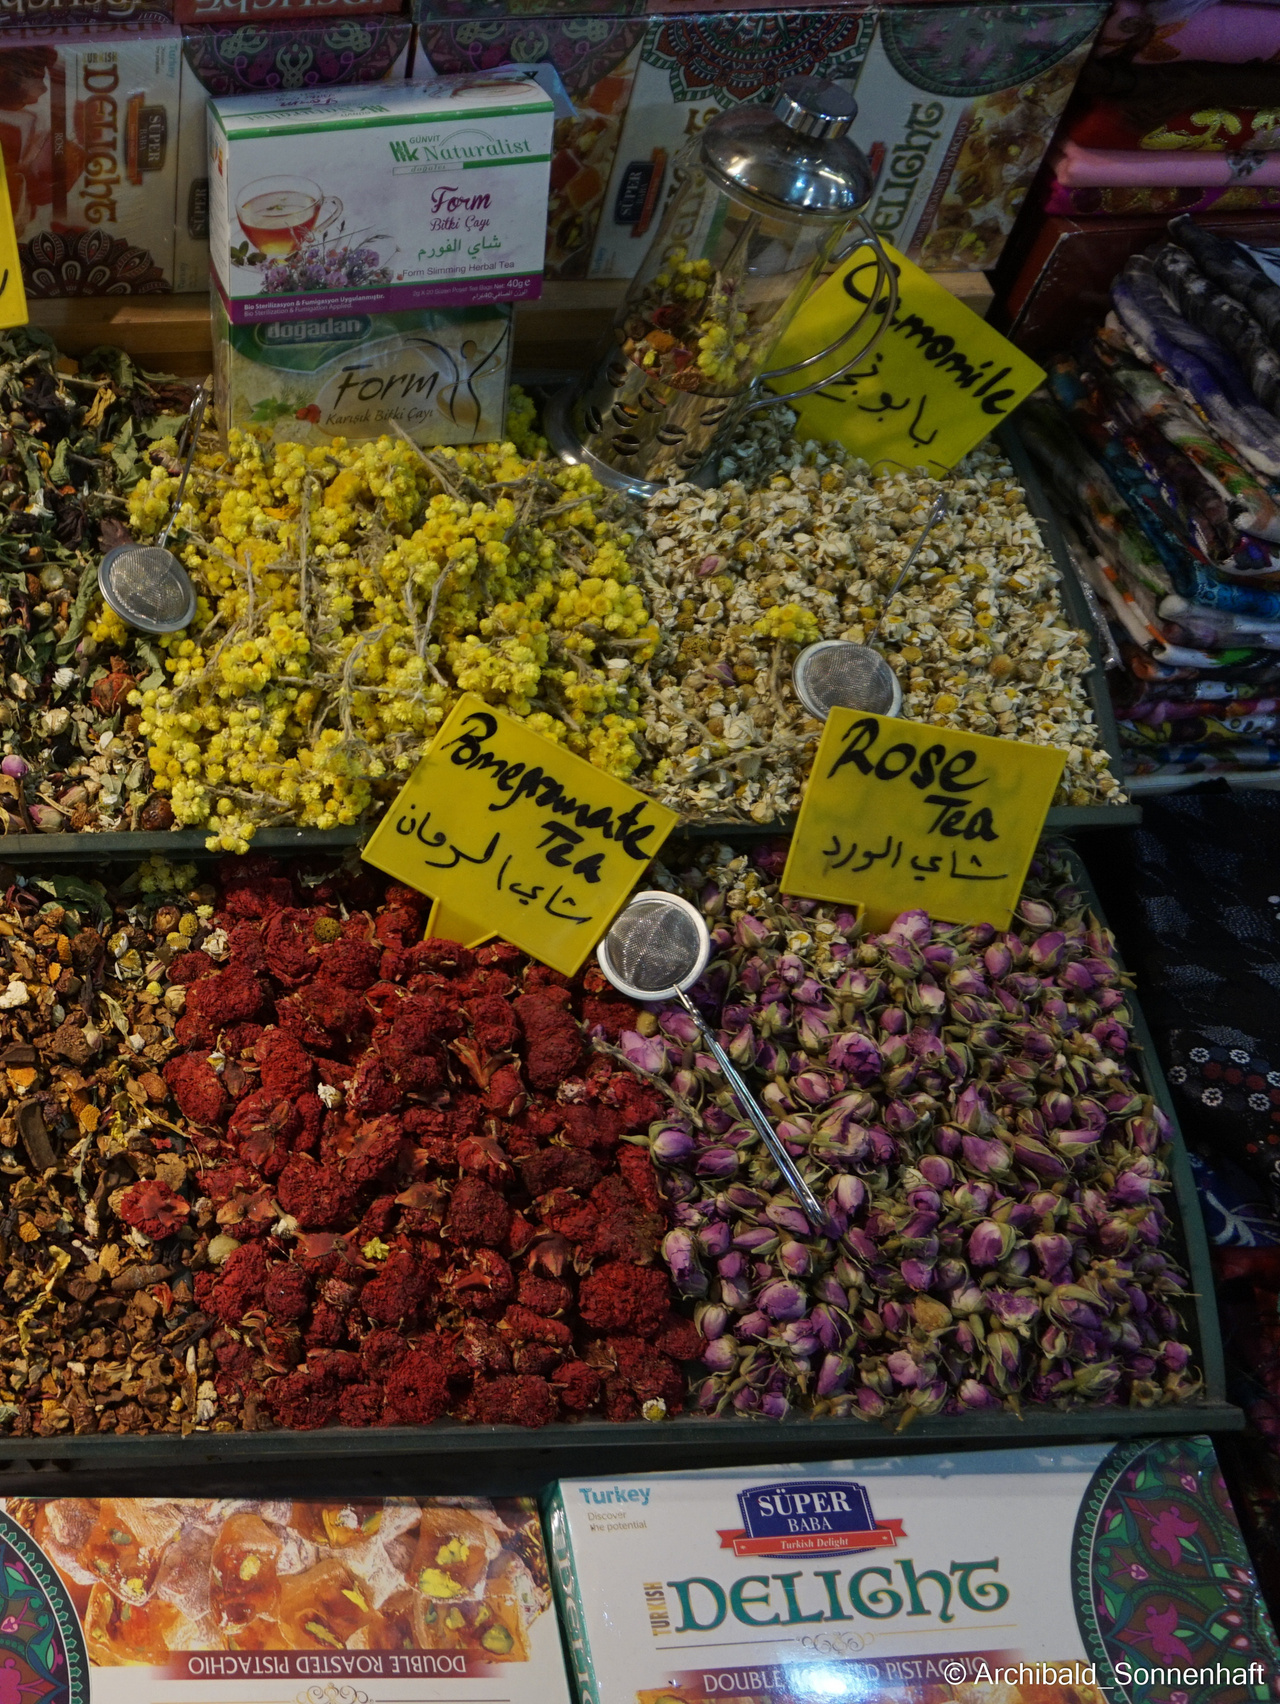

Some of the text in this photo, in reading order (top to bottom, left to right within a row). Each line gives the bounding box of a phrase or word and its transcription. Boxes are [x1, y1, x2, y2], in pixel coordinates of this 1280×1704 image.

[54, 132, 63, 155] ROSE
[423, 138, 533, 162] Naturalist
[430, 186, 492, 214] Form
[430, 215, 491, 232] Bitki Çayı
[417, 235, 502, 262] شاي الفورم
[402, 260, 515, 277] Form Slimming Herbal Tea
[244, 303, 255, 311] Bio
[255, 299, 295, 310] Sterilizasyon
[301, 296, 339, 307] Fumigasyon
[254, 306, 289, 316] Sterilization
[295, 304, 328, 313] Fumigation
[267, 318, 362, 340] doğadan
[843, 261, 1015, 414] Camomile
[333, 364, 440, 410] Form
[326, 406, 434, 425] Karışık Bitki Çayı
[827, 717, 989, 793] Rose
[923, 794, 999, 842] Tea
[536, 820, 607, 883] Tea
[822, 835, 1008, 881] شاي الورد
[578, 1485, 652, 1507] Turkey
[758, 1487, 853, 1519] SÜPER
[587, 1511, 628, 1522] Discover
[590, 1518, 648, 1534] the potential
[788, 1516, 834, 1534] BABA
[779, 1535, 849, 1551] Turkish Delight
[667, 1556, 1011, 1633] DELIGHT
[642, 1581, 669, 1637] TURKISH
[188, 1655, 467, 1675] DOUBLE ROASTED PISTACHIO
[703, 1669, 785, 1693] DOUBLE
